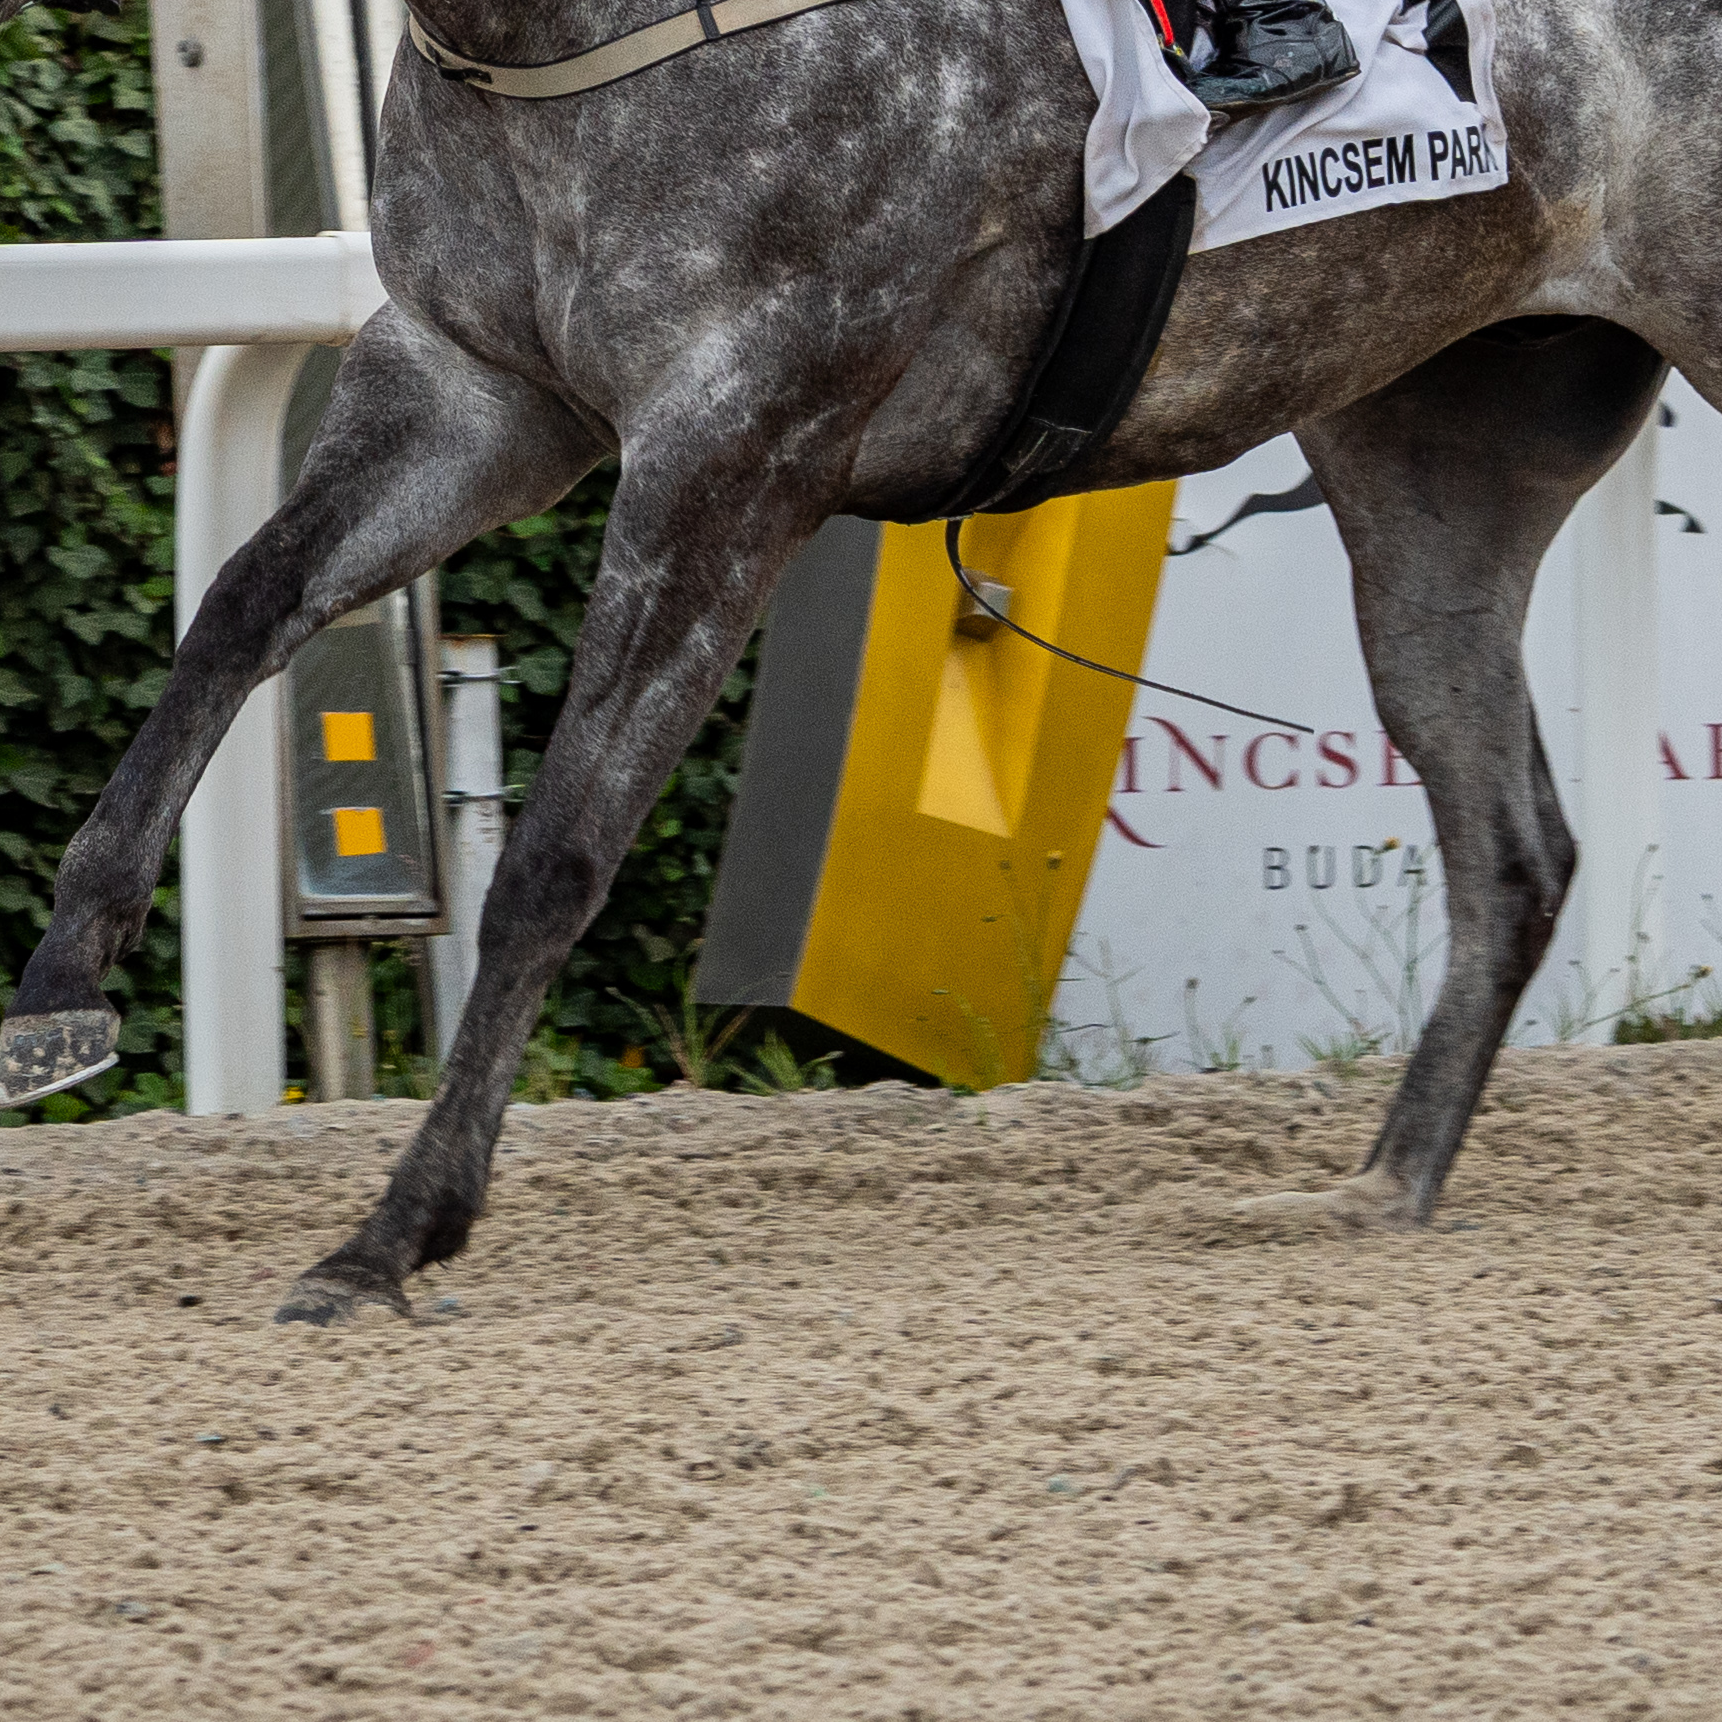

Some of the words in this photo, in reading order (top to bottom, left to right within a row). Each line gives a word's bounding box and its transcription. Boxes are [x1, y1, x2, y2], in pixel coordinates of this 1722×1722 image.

[1262, 133, 1417, 212] KINCSEM
[1107, 715, 1424, 849] INCSE
[1262, 843, 1431, 891] BUDA
